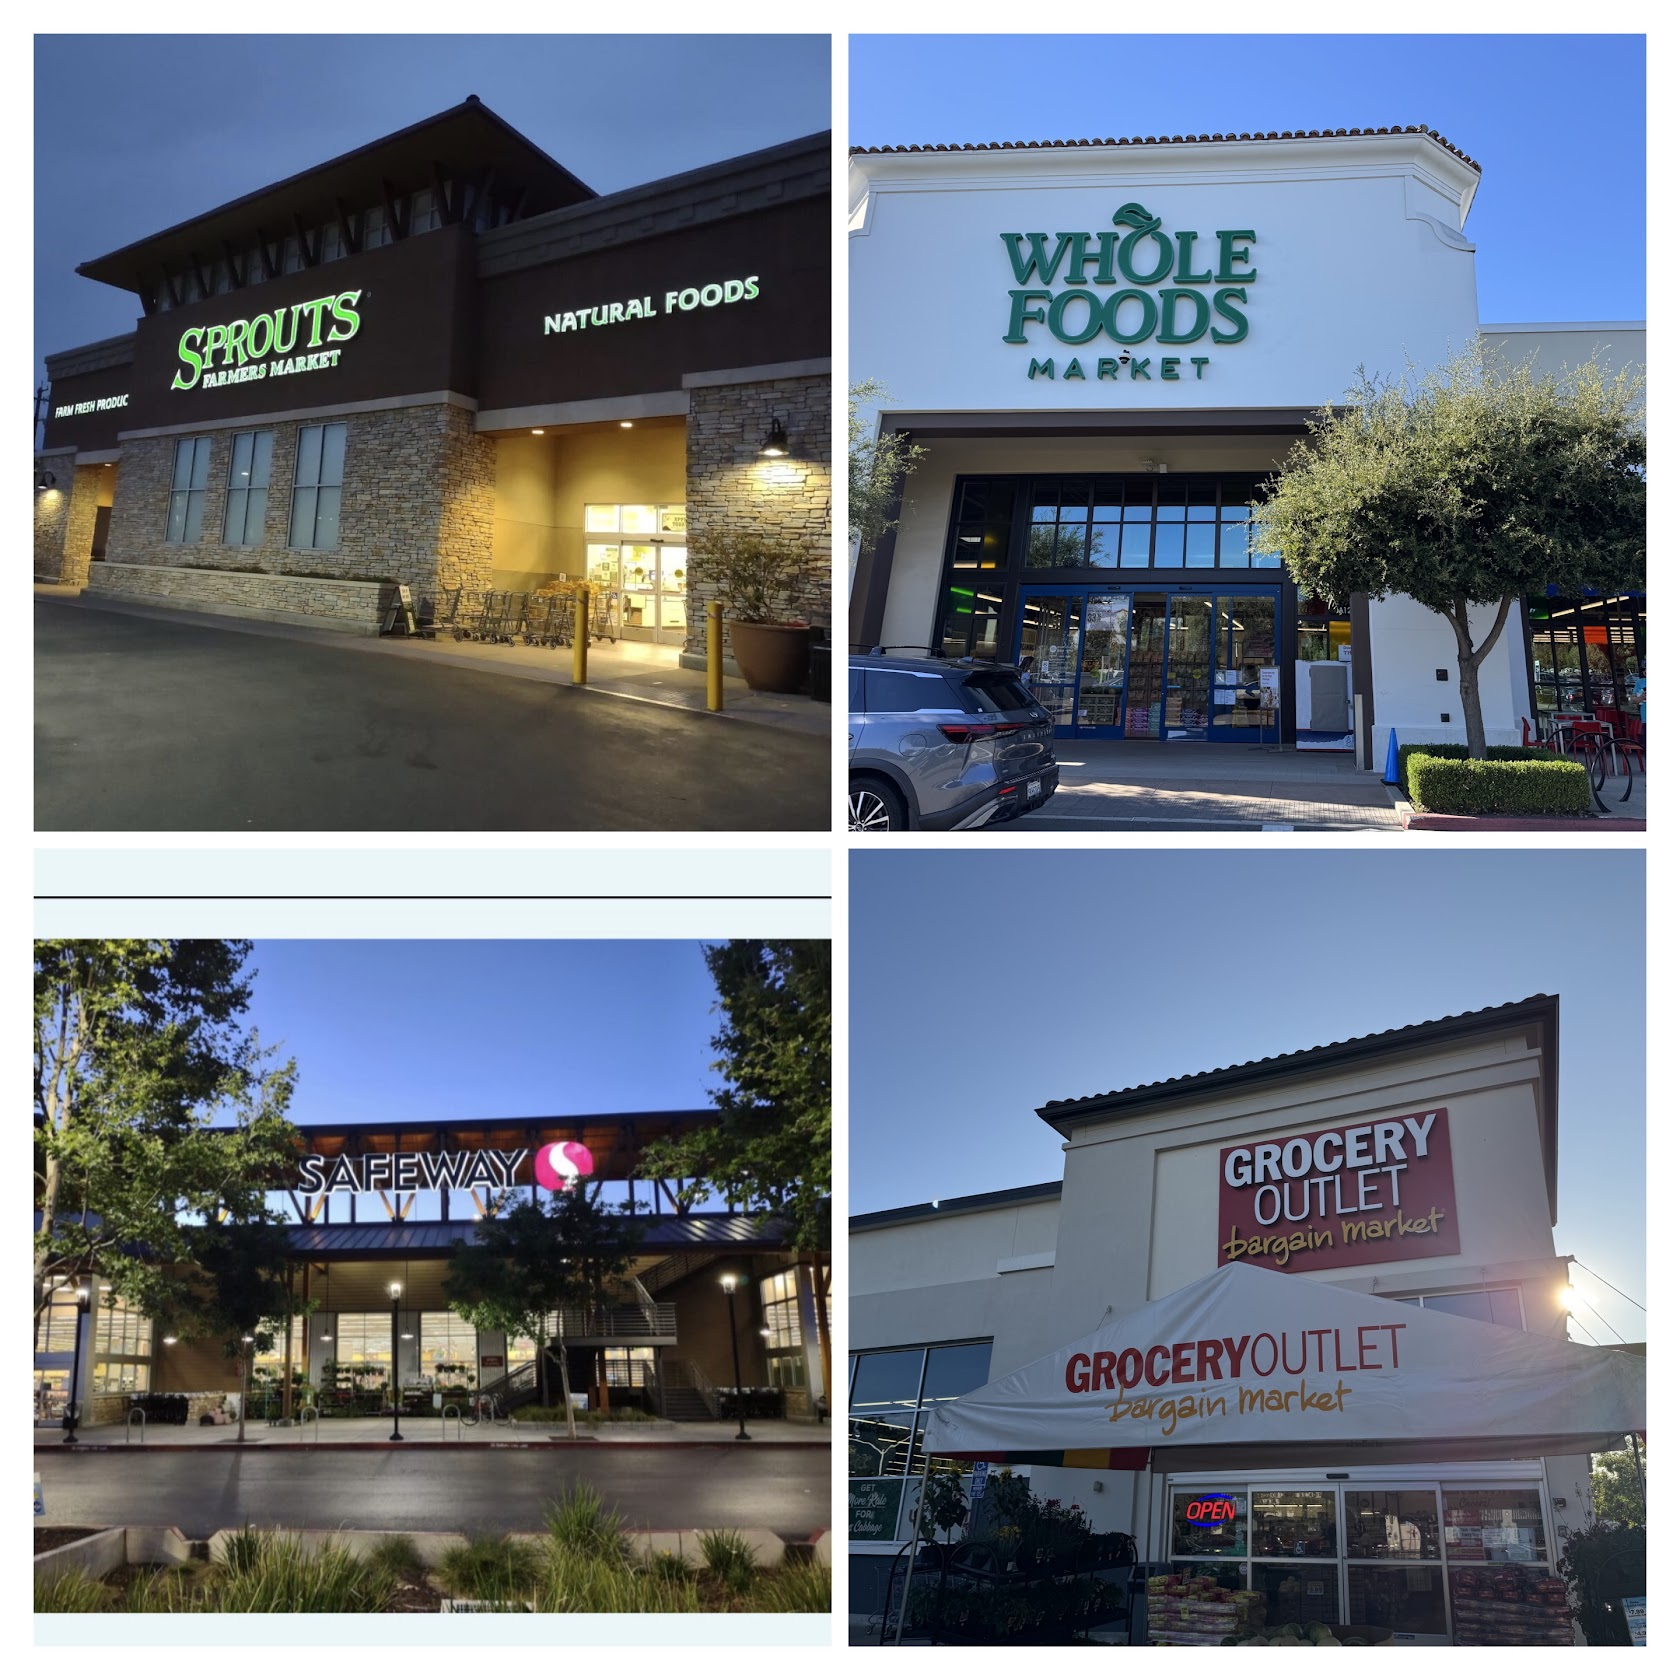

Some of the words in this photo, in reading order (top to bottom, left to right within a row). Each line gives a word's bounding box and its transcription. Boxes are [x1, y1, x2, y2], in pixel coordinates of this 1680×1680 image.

[1000, 226, 1257, 286] WHOLE
[543, 296, 657, 335] NATURAL
[665, 276, 760, 313] FOODS
[1002, 287, 1249, 345] FOODS
[171, 289, 362, 390] SPROUTS
[202, 362, 266, 389] FARMERS
[269, 349, 341, 377] MARKET
[1027, 356, 1210, 381] MARKET
[55, 405, 74, 419] FARM
[74, 402, 96, 415] FRESH
[97, 394, 129, 411] PRODUC
[298, 1147, 529, 1196] SAFEWAY
[1224, 1113, 1437, 1188] GROCERY
[1253, 1163, 1408, 1226] OUTLET
[1222, 1225, 1334, 1265] bargain
[1342, 1206, 1443, 1244] market
[1104, 1382, 1227, 1436] bargain
[1239, 1379, 1353, 1415] market
[860, 1483, 876, 1492] GET
[1186, 1501, 1236, 1520] OPEN
[853, 1519, 883, 1536] Cabbage
[855, 1510, 872, 1519] FOR
